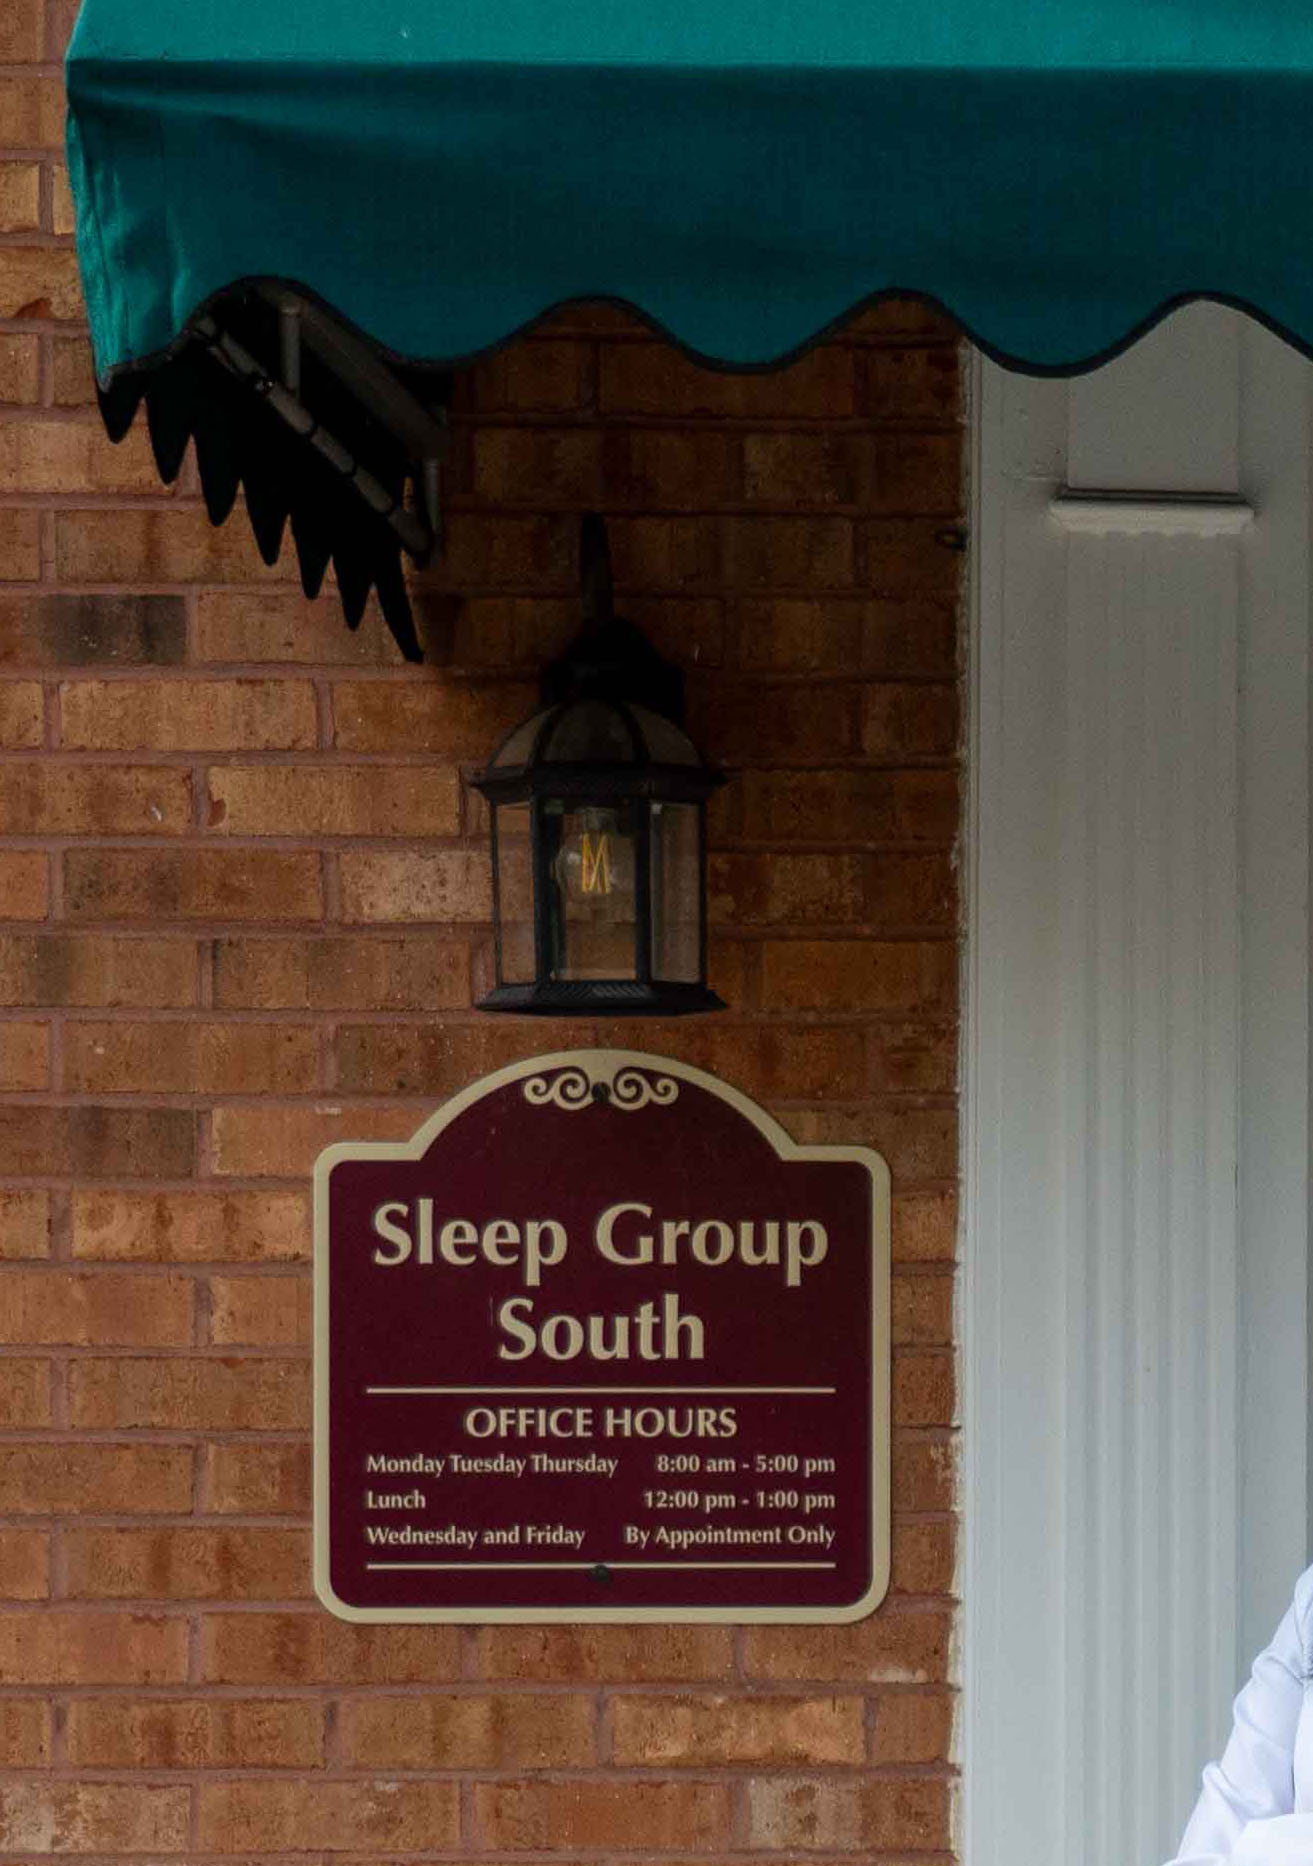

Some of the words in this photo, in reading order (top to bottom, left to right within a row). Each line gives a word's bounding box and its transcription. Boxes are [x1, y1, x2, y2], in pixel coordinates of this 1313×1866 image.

[373, 1197, 568, 1287] Sleep
[595, 1203, 828, 1287] Group
[498, 1293, 705, 1361] South
[465, 1407, 593, 1438] OFFICE
[605, 1407, 738, 1438] HOURS
[366, 1453, 446, 1478] Monday
[449, 1453, 527, 1478] Tuesday
[530, 1453, 619, 1478] Thursday
[657, 1454, 701, 1473] 8:00
[705, 1458, 736, 1473] am
[755, 1454, 799, 1473] 5:00
[804, 1458, 836, 1478] pm
[366, 1489, 427, 1509] Lunch
[644, 1490, 699, 1509] 12:00
[705, 1494, 736, 1514] pm
[756, 1490, 799, 1509] 1:00
[804, 1494, 836, 1514] pm
[366, 1525, 478, 1550] Wednesday
[483, 1525, 520, 1545] and
[526, 1524, 586, 1550] Friday
[625, 1525, 651, 1550] By
[655, 1525, 782, 1550] Appointment
[787, 1524, 836, 1550] Only
